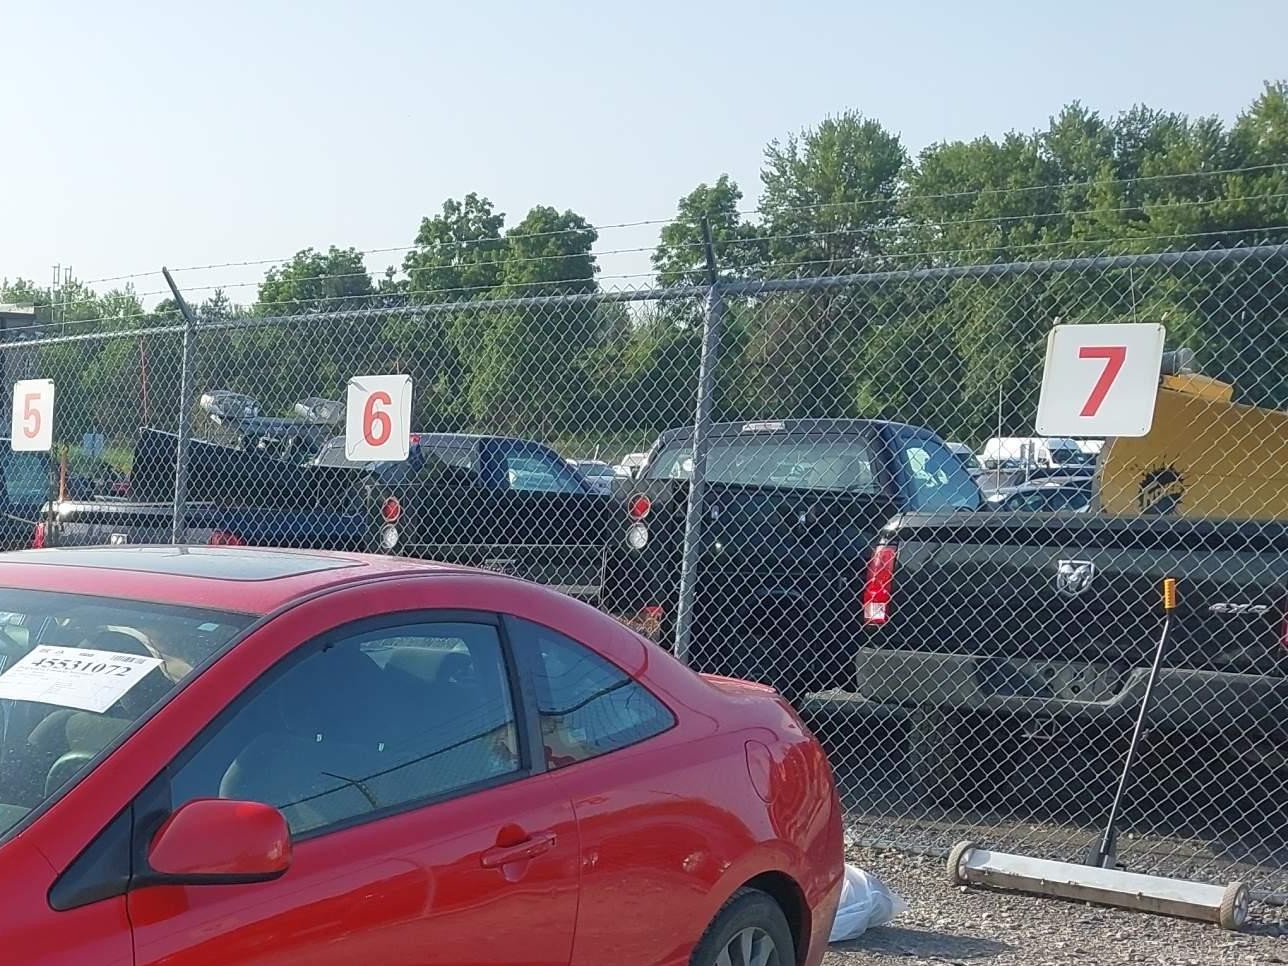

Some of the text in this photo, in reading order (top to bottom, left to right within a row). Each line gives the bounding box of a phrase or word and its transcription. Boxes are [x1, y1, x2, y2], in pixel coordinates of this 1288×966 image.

[1079, 346, 1127, 417] 7
[23, 392, 42, 439] 5
[363, 391, 392, 447] 6
[32, 658, 132, 677] 45531072
